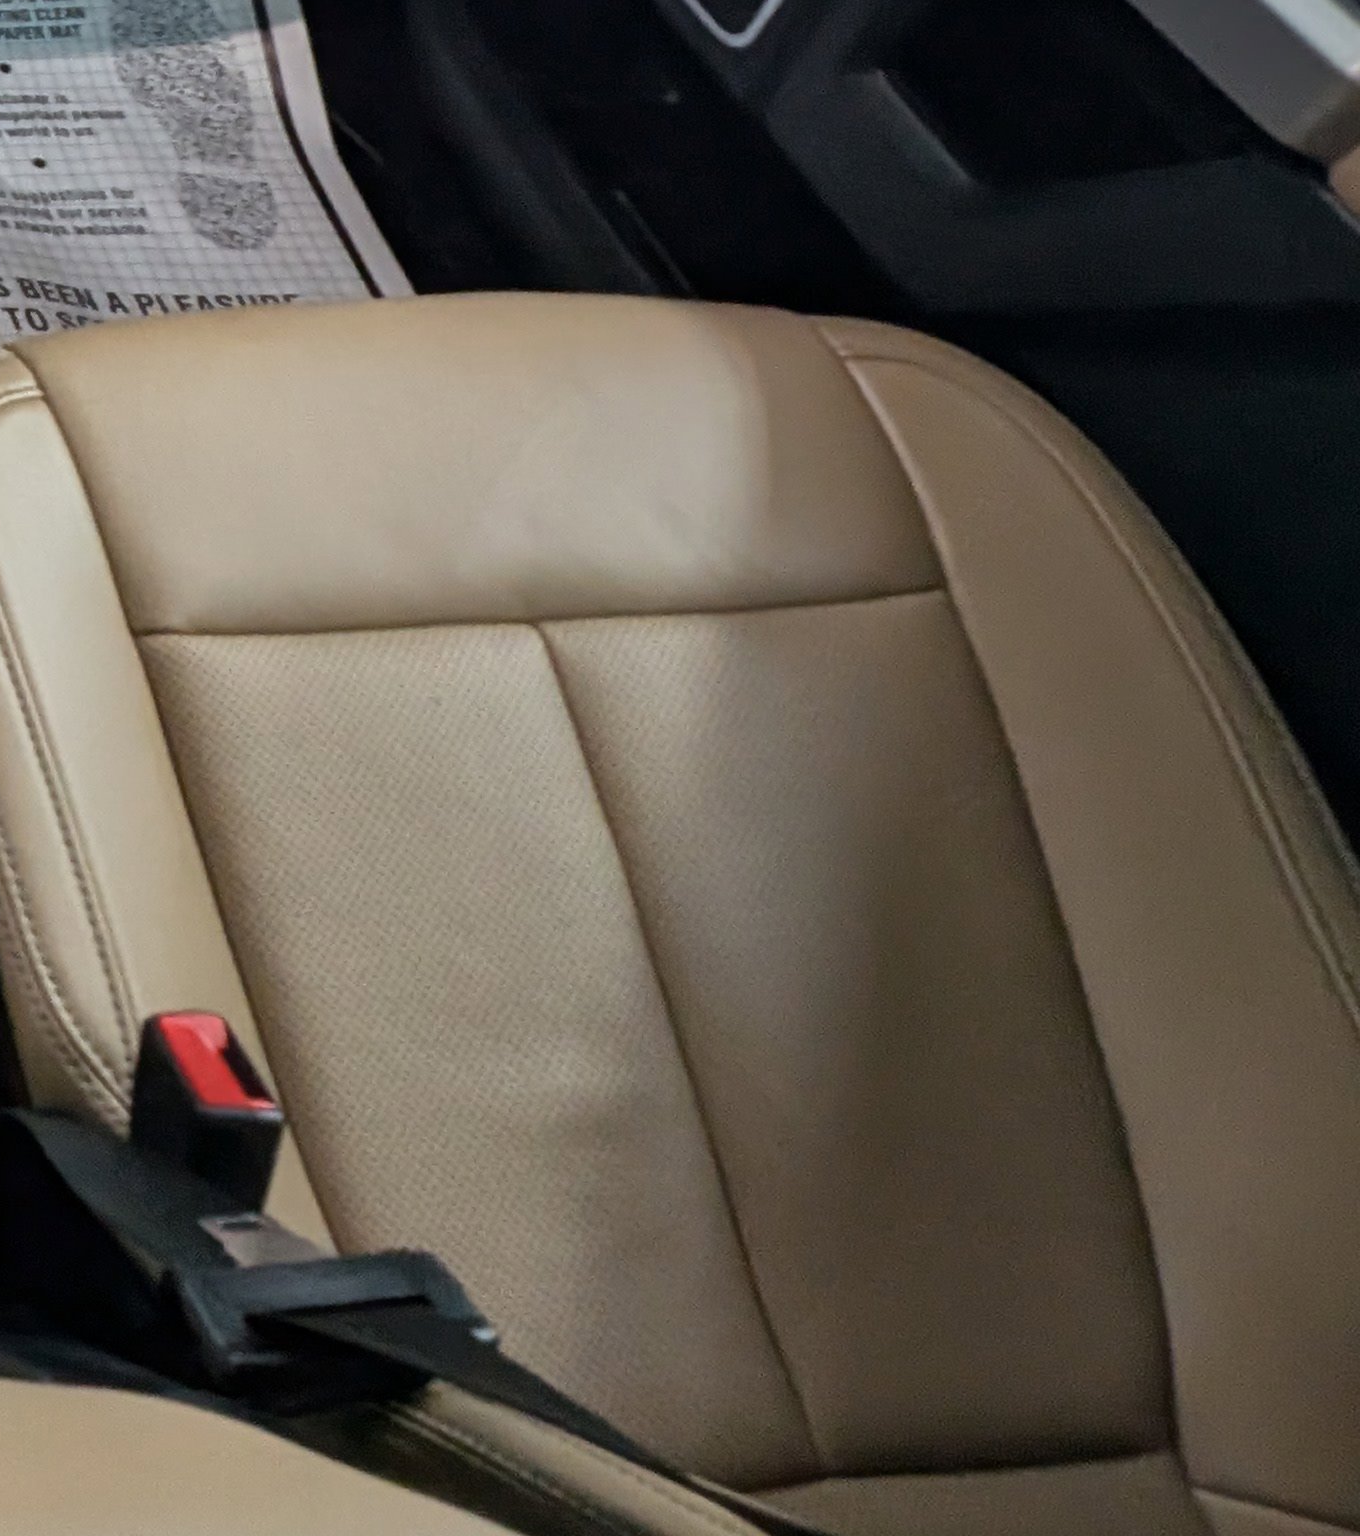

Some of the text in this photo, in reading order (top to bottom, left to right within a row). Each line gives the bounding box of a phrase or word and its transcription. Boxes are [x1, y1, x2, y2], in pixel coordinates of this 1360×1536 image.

[34, 6, 86, 21] CLEAN
[48, 23, 81, 38] MAT
[71, 110, 126, 122] person
[5, 127, 50, 137] world
[53, 127, 70, 137] to
[10, 189, 107, 205] suggestions
[110, 187, 134, 199] for
[56, 208, 82, 219] our
[87, 207, 147, 218] service
[14, 220, 70, 237] always
[16, 277, 99, 312] BEEN
[105, 292, 130, 314] A
[0, 307, 50, 333] TO
